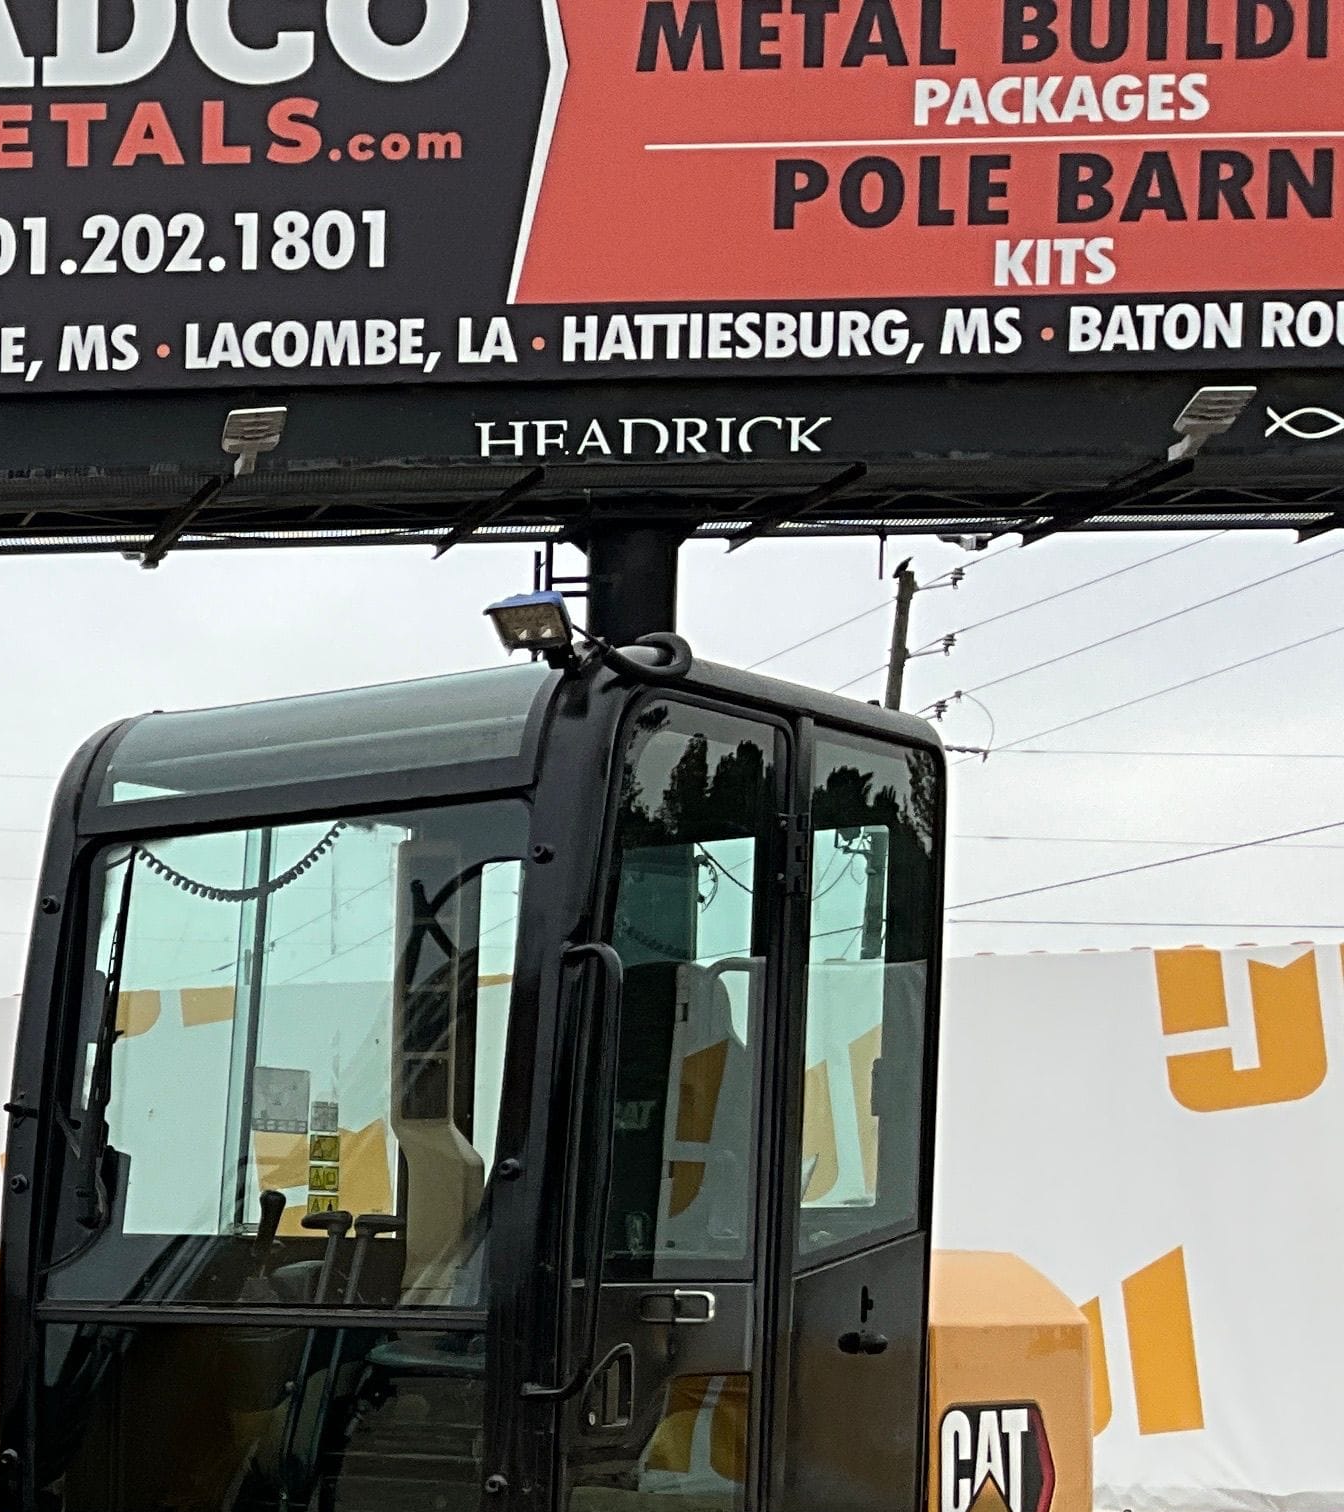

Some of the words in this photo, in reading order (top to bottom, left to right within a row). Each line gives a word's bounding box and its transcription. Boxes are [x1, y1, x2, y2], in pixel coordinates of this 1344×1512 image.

[635, 0, 957, 72] METAL
[913, 73, 1210, 126] PACKAGES
[773, 153, 1012, 230] POLE
[1056, 148, 1335, 224] BARN
[994, 237, 1117, 287] KITS
[58, 324, 139, 372] MS
[184, 318, 442, 374] LACOMBE,
[458, 317, 519, 363] LA
[563, 310, 924, 364] HATTIESBURG,
[939, 308, 1022, 355] MS
[1068, 302, 1244, 352] BATON
[1261, 300, 1344, 348] RO
[475, 417, 832, 457] HEADRICK
